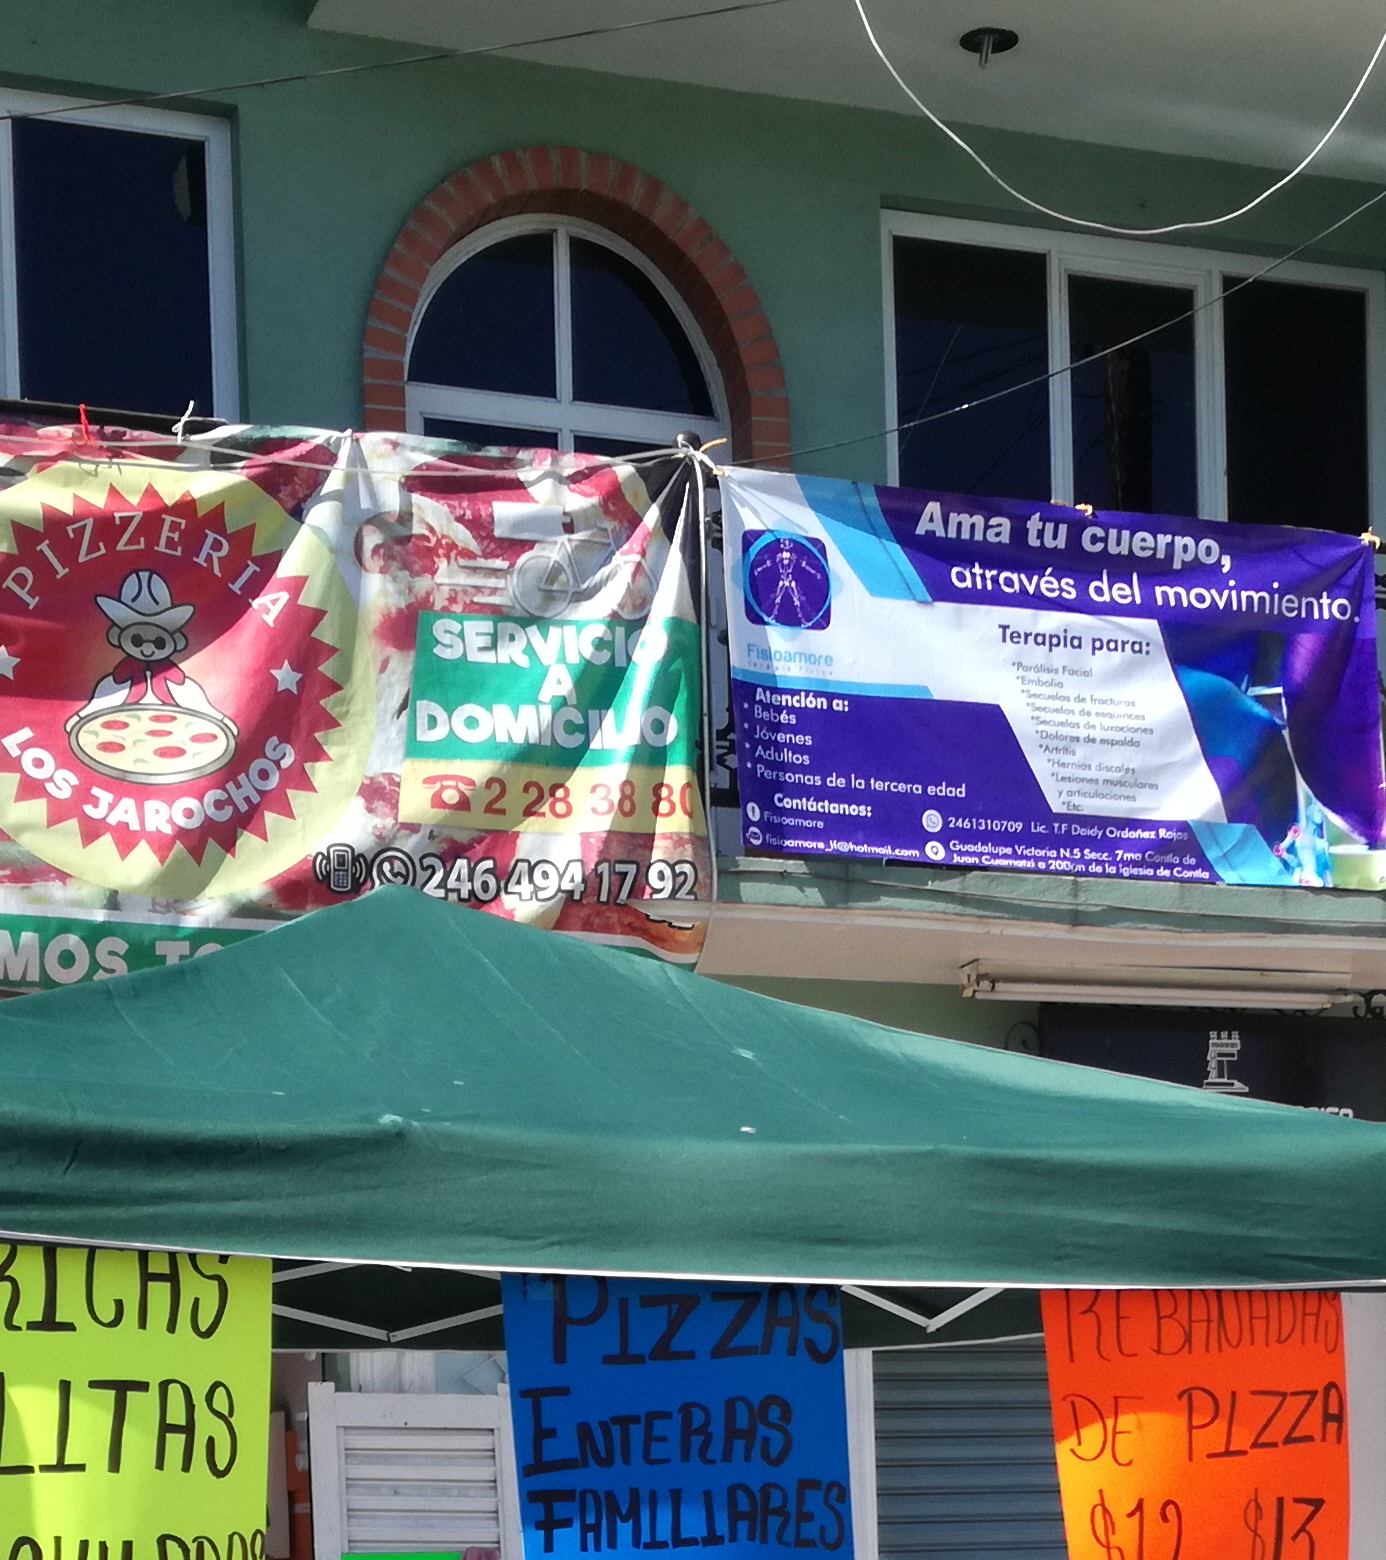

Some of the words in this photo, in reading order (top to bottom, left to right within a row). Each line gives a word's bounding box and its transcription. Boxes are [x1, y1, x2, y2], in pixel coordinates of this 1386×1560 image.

[915, 501, 1011, 544] Ama
[1027, 512, 1067, 549] tu
[1081, 525, 1232, 573] cuerpo,
[2, 510, 290, 628] PIZZERIA
[950, 561, 1077, 600] através
[1089, 569, 1141, 605] del
[1156, 579, 1361, 623] movimiento.
[432, 620, 669, 668] SERVICIO
[998, 624, 1082, 653] Terapia
[1092, 637, 1151, 656] para:
[747, 643, 834, 667] Fisioamore
[1017, 661, 1059, 675] Parálisis
[1062, 666, 1093, 677] Facial
[537, 664, 570, 704] A
[1021, 676, 1064, 689] Embolia
[755, 687, 827, 709] Atención
[832, 698, 849, 712] a:
[1026, 690, 1071, 702] Secuelas
[1074, 693, 1087, 704] de
[1090, 694, 1136, 708] fracturas
[1031, 703, 1075, 716] Secuelas
[1079, 706, 1092, 717] de
[415, 699, 678, 750] DOMICILIO
[754, 705, 797, 725] Bebés
[1036, 716, 1080, 729] Secuelas
[1084, 718, 1096, 731] de
[1100, 720, 1154, 735] luxaciones
[754, 725, 812, 746] Jóvenes
[1040, 730, 1080, 743] Dolores
[1083, 732, 1097, 744] de
[1099, 735, 1140, 749] espalda
[755, 745, 810, 765] Adultos
[1051, 758, 1092, 771] Hernias
[1095, 762, 1135, 775] discales
[1, 727, 79, 801] LOS
[82, 735, 296, 835] JAROCHOS
[757, 764, 822, 786] Personas
[826, 773, 846, 788] de
[851, 775, 865, 790] la
[870, 778, 922, 794] tercera
[927, 782, 966, 797] edad
[1055, 771, 1099, 785] Lesiones
[1103, 775, 1159, 791] musculares
[484, 778, 508, 817] 2
[521, 781, 573, 820] 28
[589, 782, 637, 818] 38
[773, 793, 872, 817] Contáctanos:
[1057, 789, 1063, 798] y
[1066, 788, 1137, 802] articulaciones
[1066, 801, 1084, 812] Etc.
[763, 811, 824, 829] Fisioamore
[948, 816, 1023, 833] 2461310709
[1031, 822, 1049, 834] Lic.
[1158, 829, 1188, 842] Rojas
[950, 840, 1012, 856] Guadalupe
[1015, 845, 1058, 858] Victoria
[1186, 854, 1196, 866] de
[419, 858, 497, 900] 246
[511, 861, 585, 902] 494
[596, 861, 637, 901] 17
[646, 862, 698, 901] 92
[953, 854, 979, 864] Juan
[1089, 862, 1103, 873] de
[1105, 863, 1116, 874] la
[1157, 867, 1170, 877] de
[1173, 867, 1210, 880] Contla
[541, 1275, 840, 1366] PIZZAS
[1065, 1290, 1342, 1363] REBANADAS
[520, 1386, 792, 1477] ENTERAS
[1062, 1394, 1143, 1466] DE
[1178, 1381, 1343, 1462] PIZZA
[526, 1477, 851, 1553] FAMILIARES
